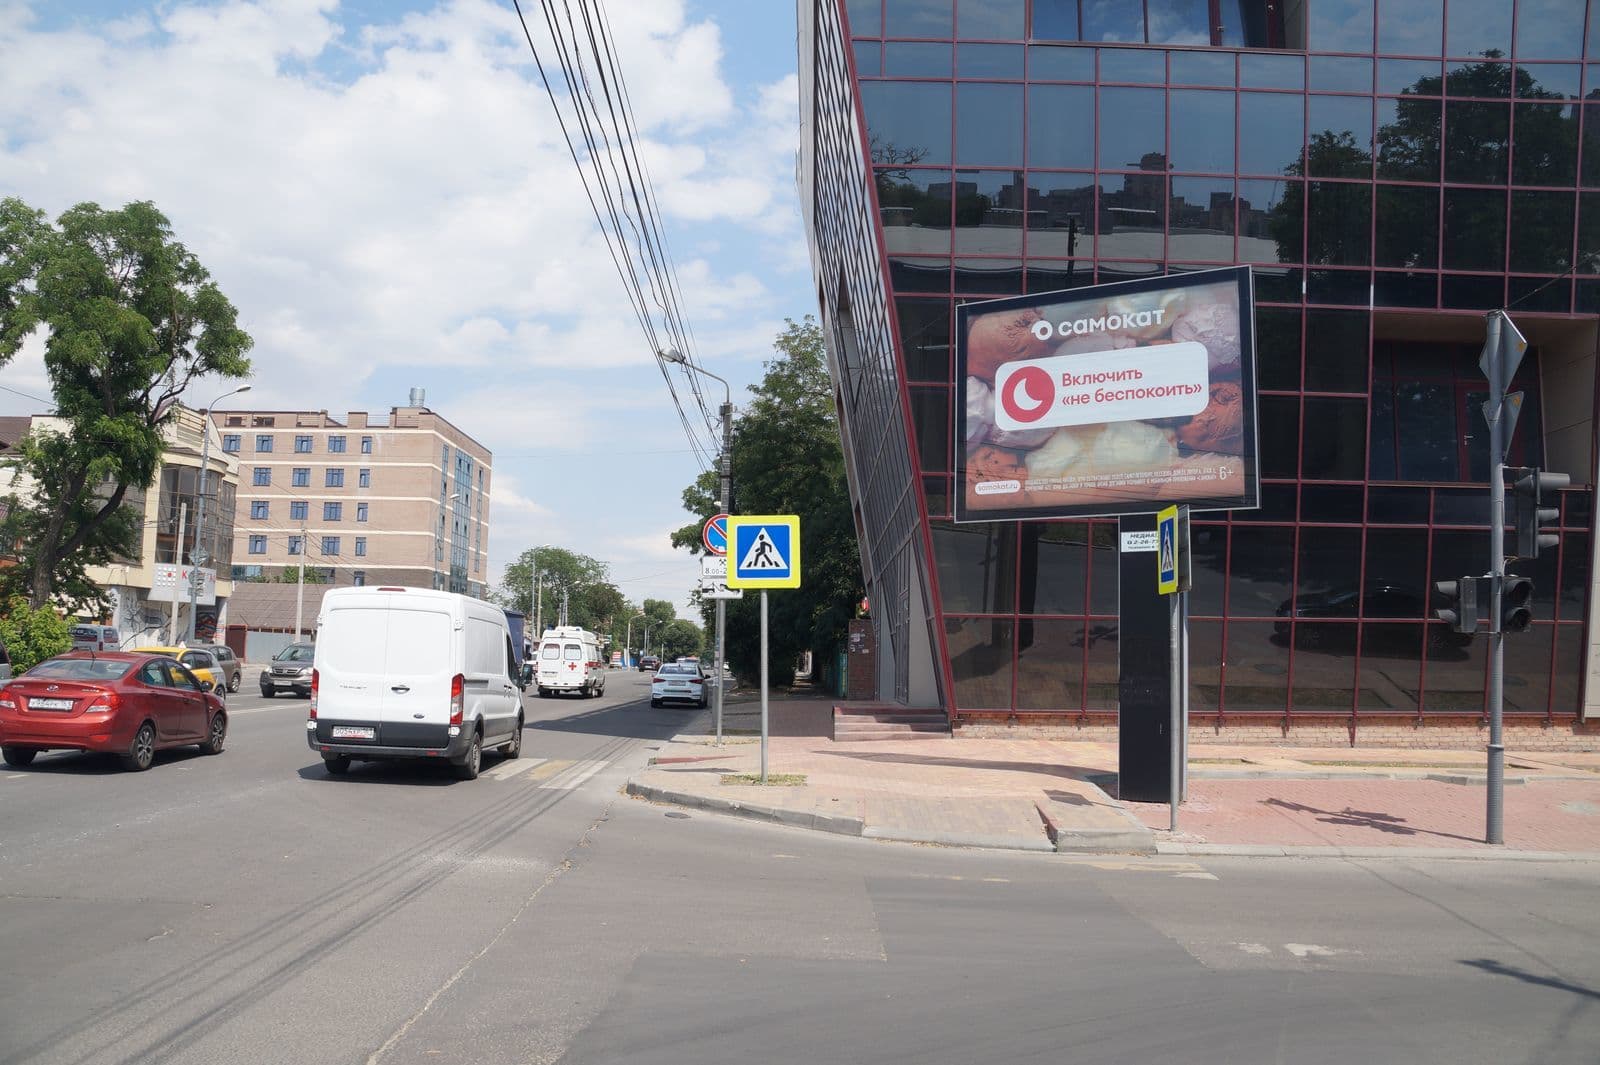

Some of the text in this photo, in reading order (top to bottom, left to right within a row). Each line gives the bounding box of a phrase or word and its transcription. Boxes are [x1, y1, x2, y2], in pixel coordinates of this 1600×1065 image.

[1057, 308, 1166, 338] самокат
[1062, 367, 1143, 388] Включить
[1061, 380, 1203, 407] «не беспокоить»
[1218, 466, 1235, 481] 6+
[977, 482, 1018, 492] samokat.ru
